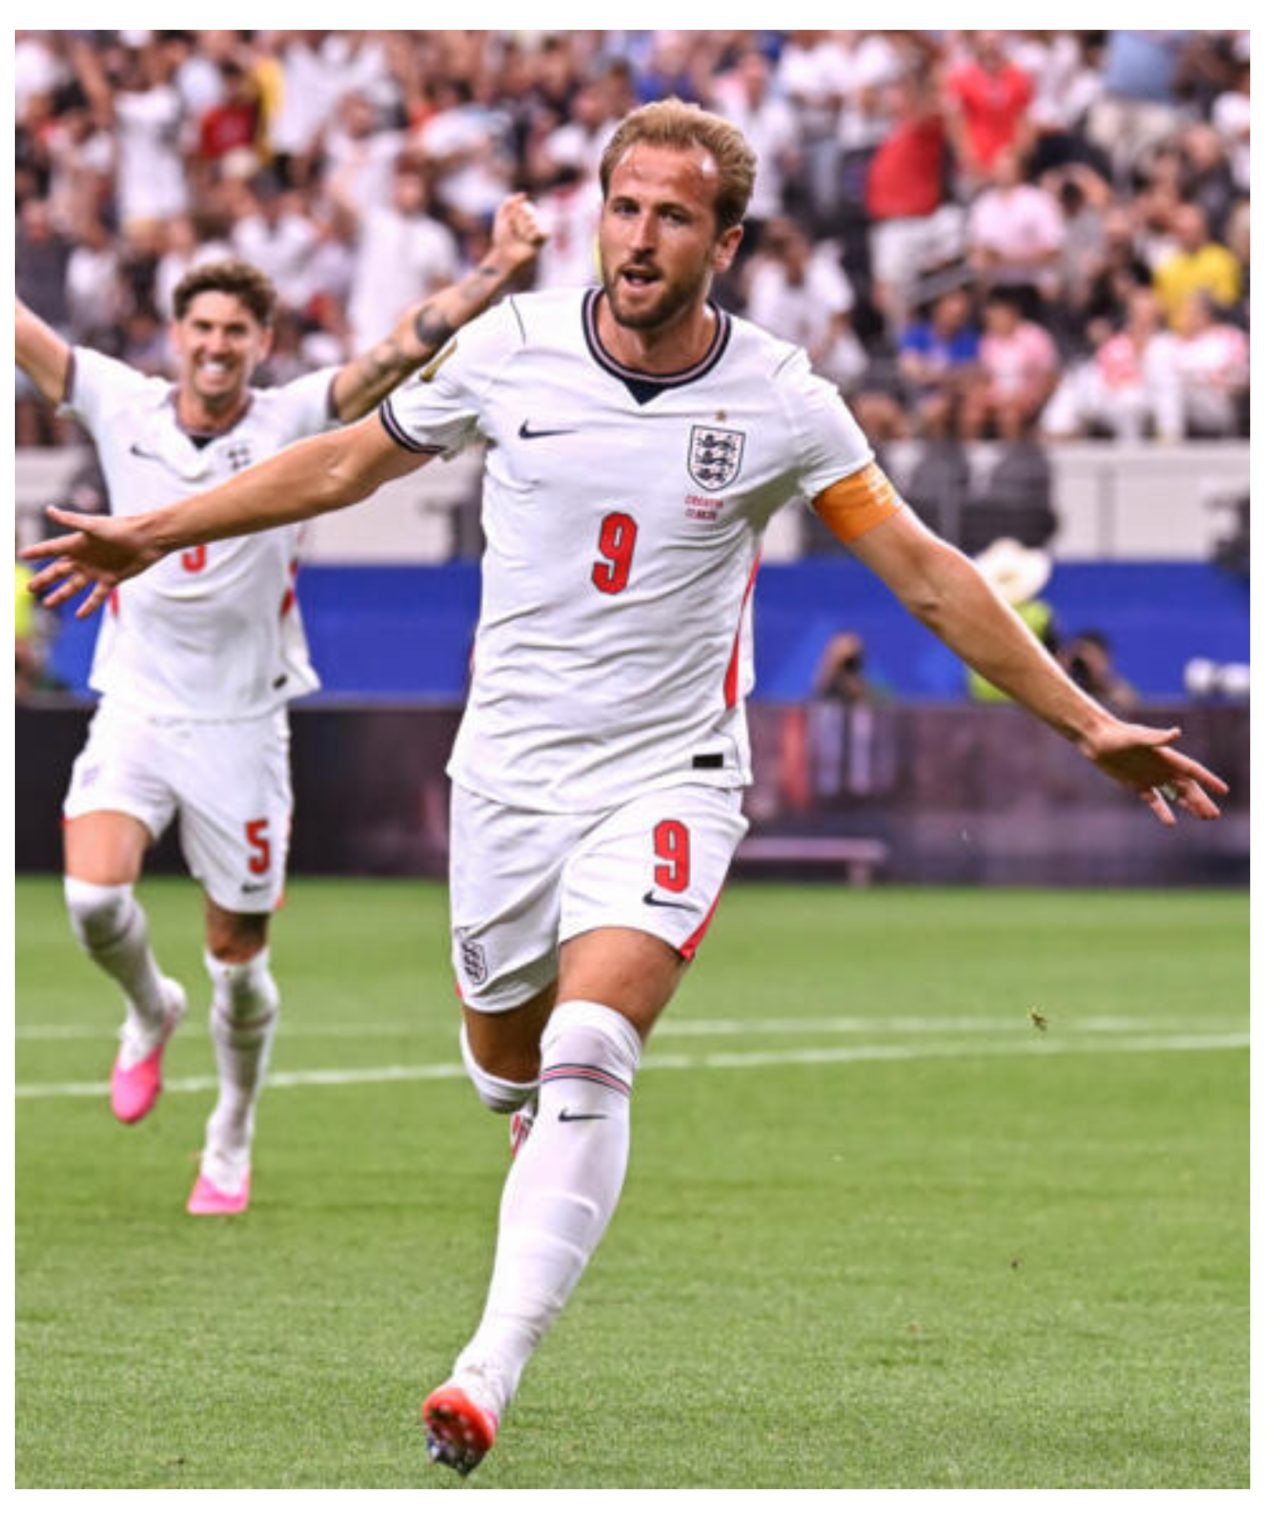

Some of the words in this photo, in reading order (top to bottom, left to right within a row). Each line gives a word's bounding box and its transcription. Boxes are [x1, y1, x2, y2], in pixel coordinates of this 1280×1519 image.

[591, 511, 639, 595] 9
[246, 819, 271, 875] 5
[653, 819, 691, 894] 9
